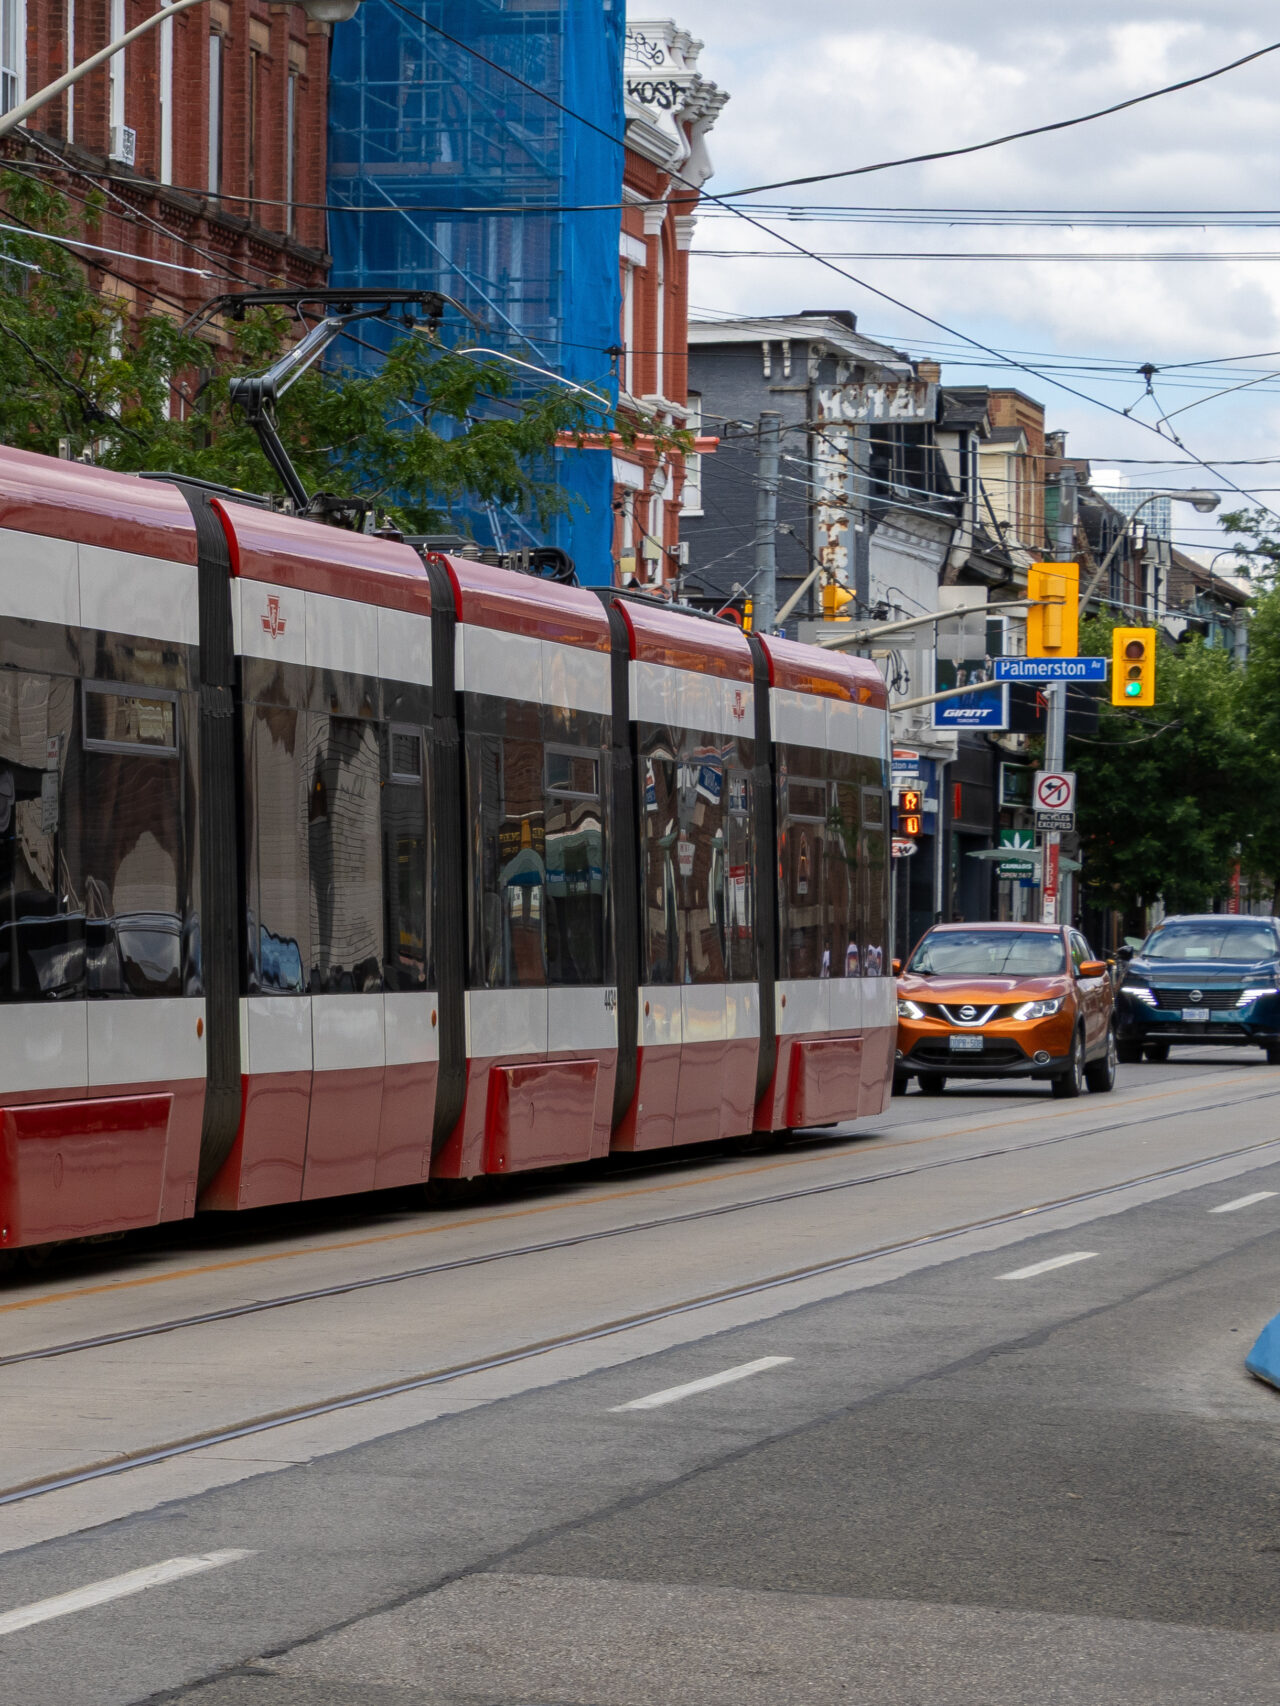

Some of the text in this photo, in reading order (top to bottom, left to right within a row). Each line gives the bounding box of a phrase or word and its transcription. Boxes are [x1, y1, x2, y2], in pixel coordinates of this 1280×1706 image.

[1000, 660, 1086, 676] Palmerston
[943, 709, 993, 718] GIANT
[892, 761, 907, 769] ston
[1039, 813, 1071, 821] BICYCLES
[1037, 821, 1072, 829] EXCEPTED
